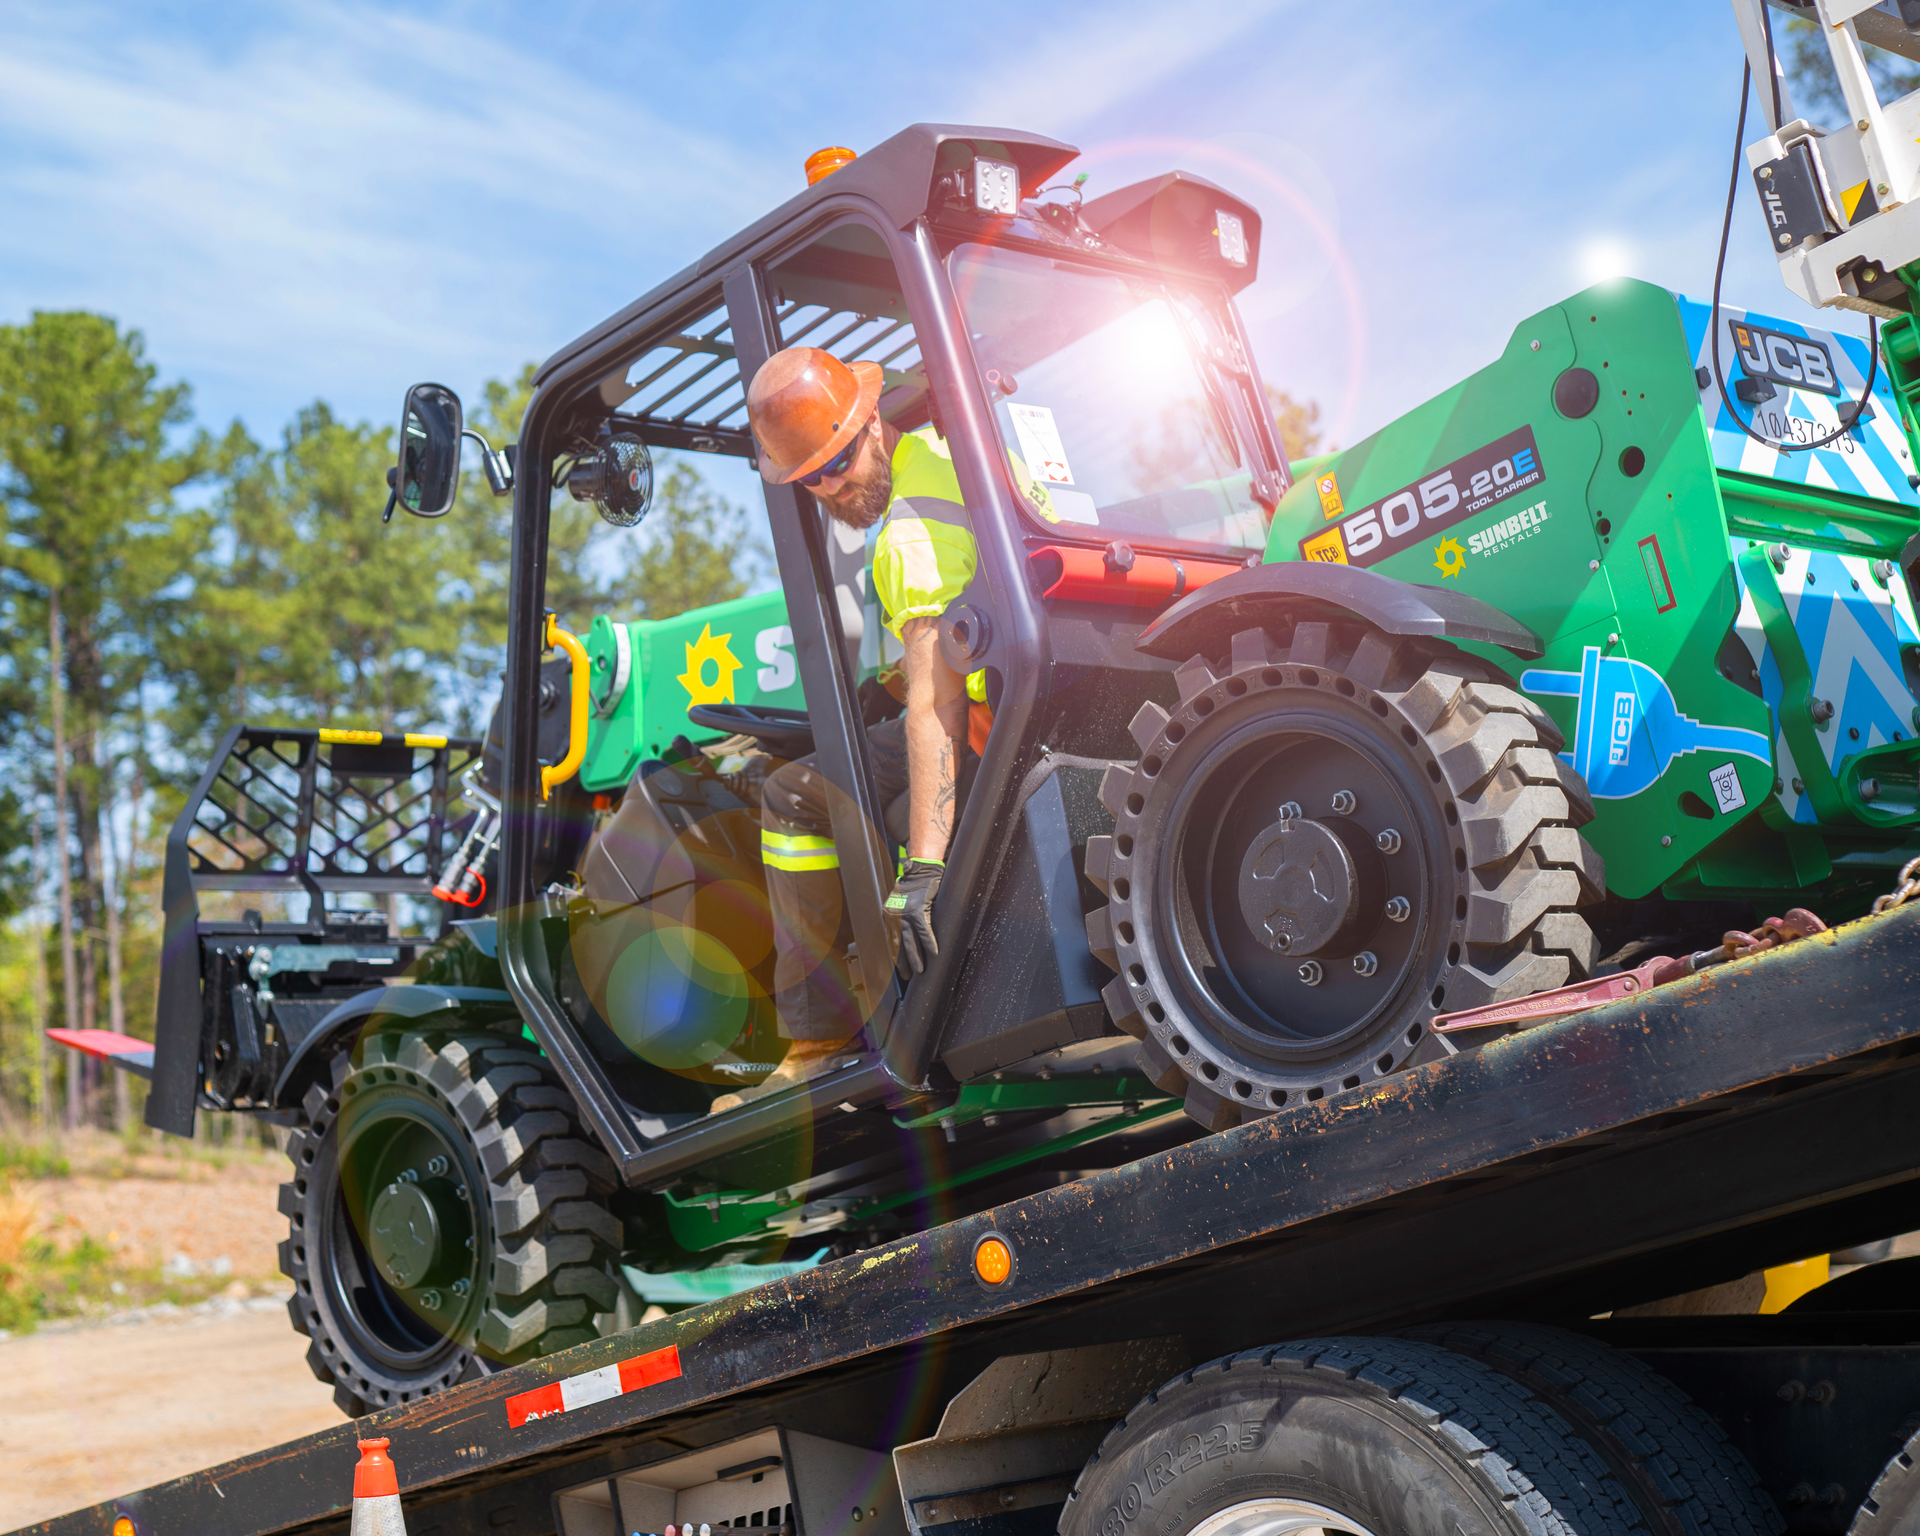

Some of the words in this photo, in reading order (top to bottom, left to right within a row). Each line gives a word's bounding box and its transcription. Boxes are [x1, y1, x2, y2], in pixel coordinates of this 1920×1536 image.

[1764, 190, 1787, 229] JLG
[1739, 330, 1834, 389] JCB
[1757, 410, 1855, 454] 10437315
[1466, 495, 1493, 512] TOOL
[1495, 471, 1539, 499] CARRIER
[1467, 500, 1548, 554] SUNBELT
[1483, 525, 1541, 558] RENTALS
[1315, 546, 1339, 563] JCB
[1611, 697, 1633, 762] JCB
[1144, 1419, 1267, 1495] R22.5
